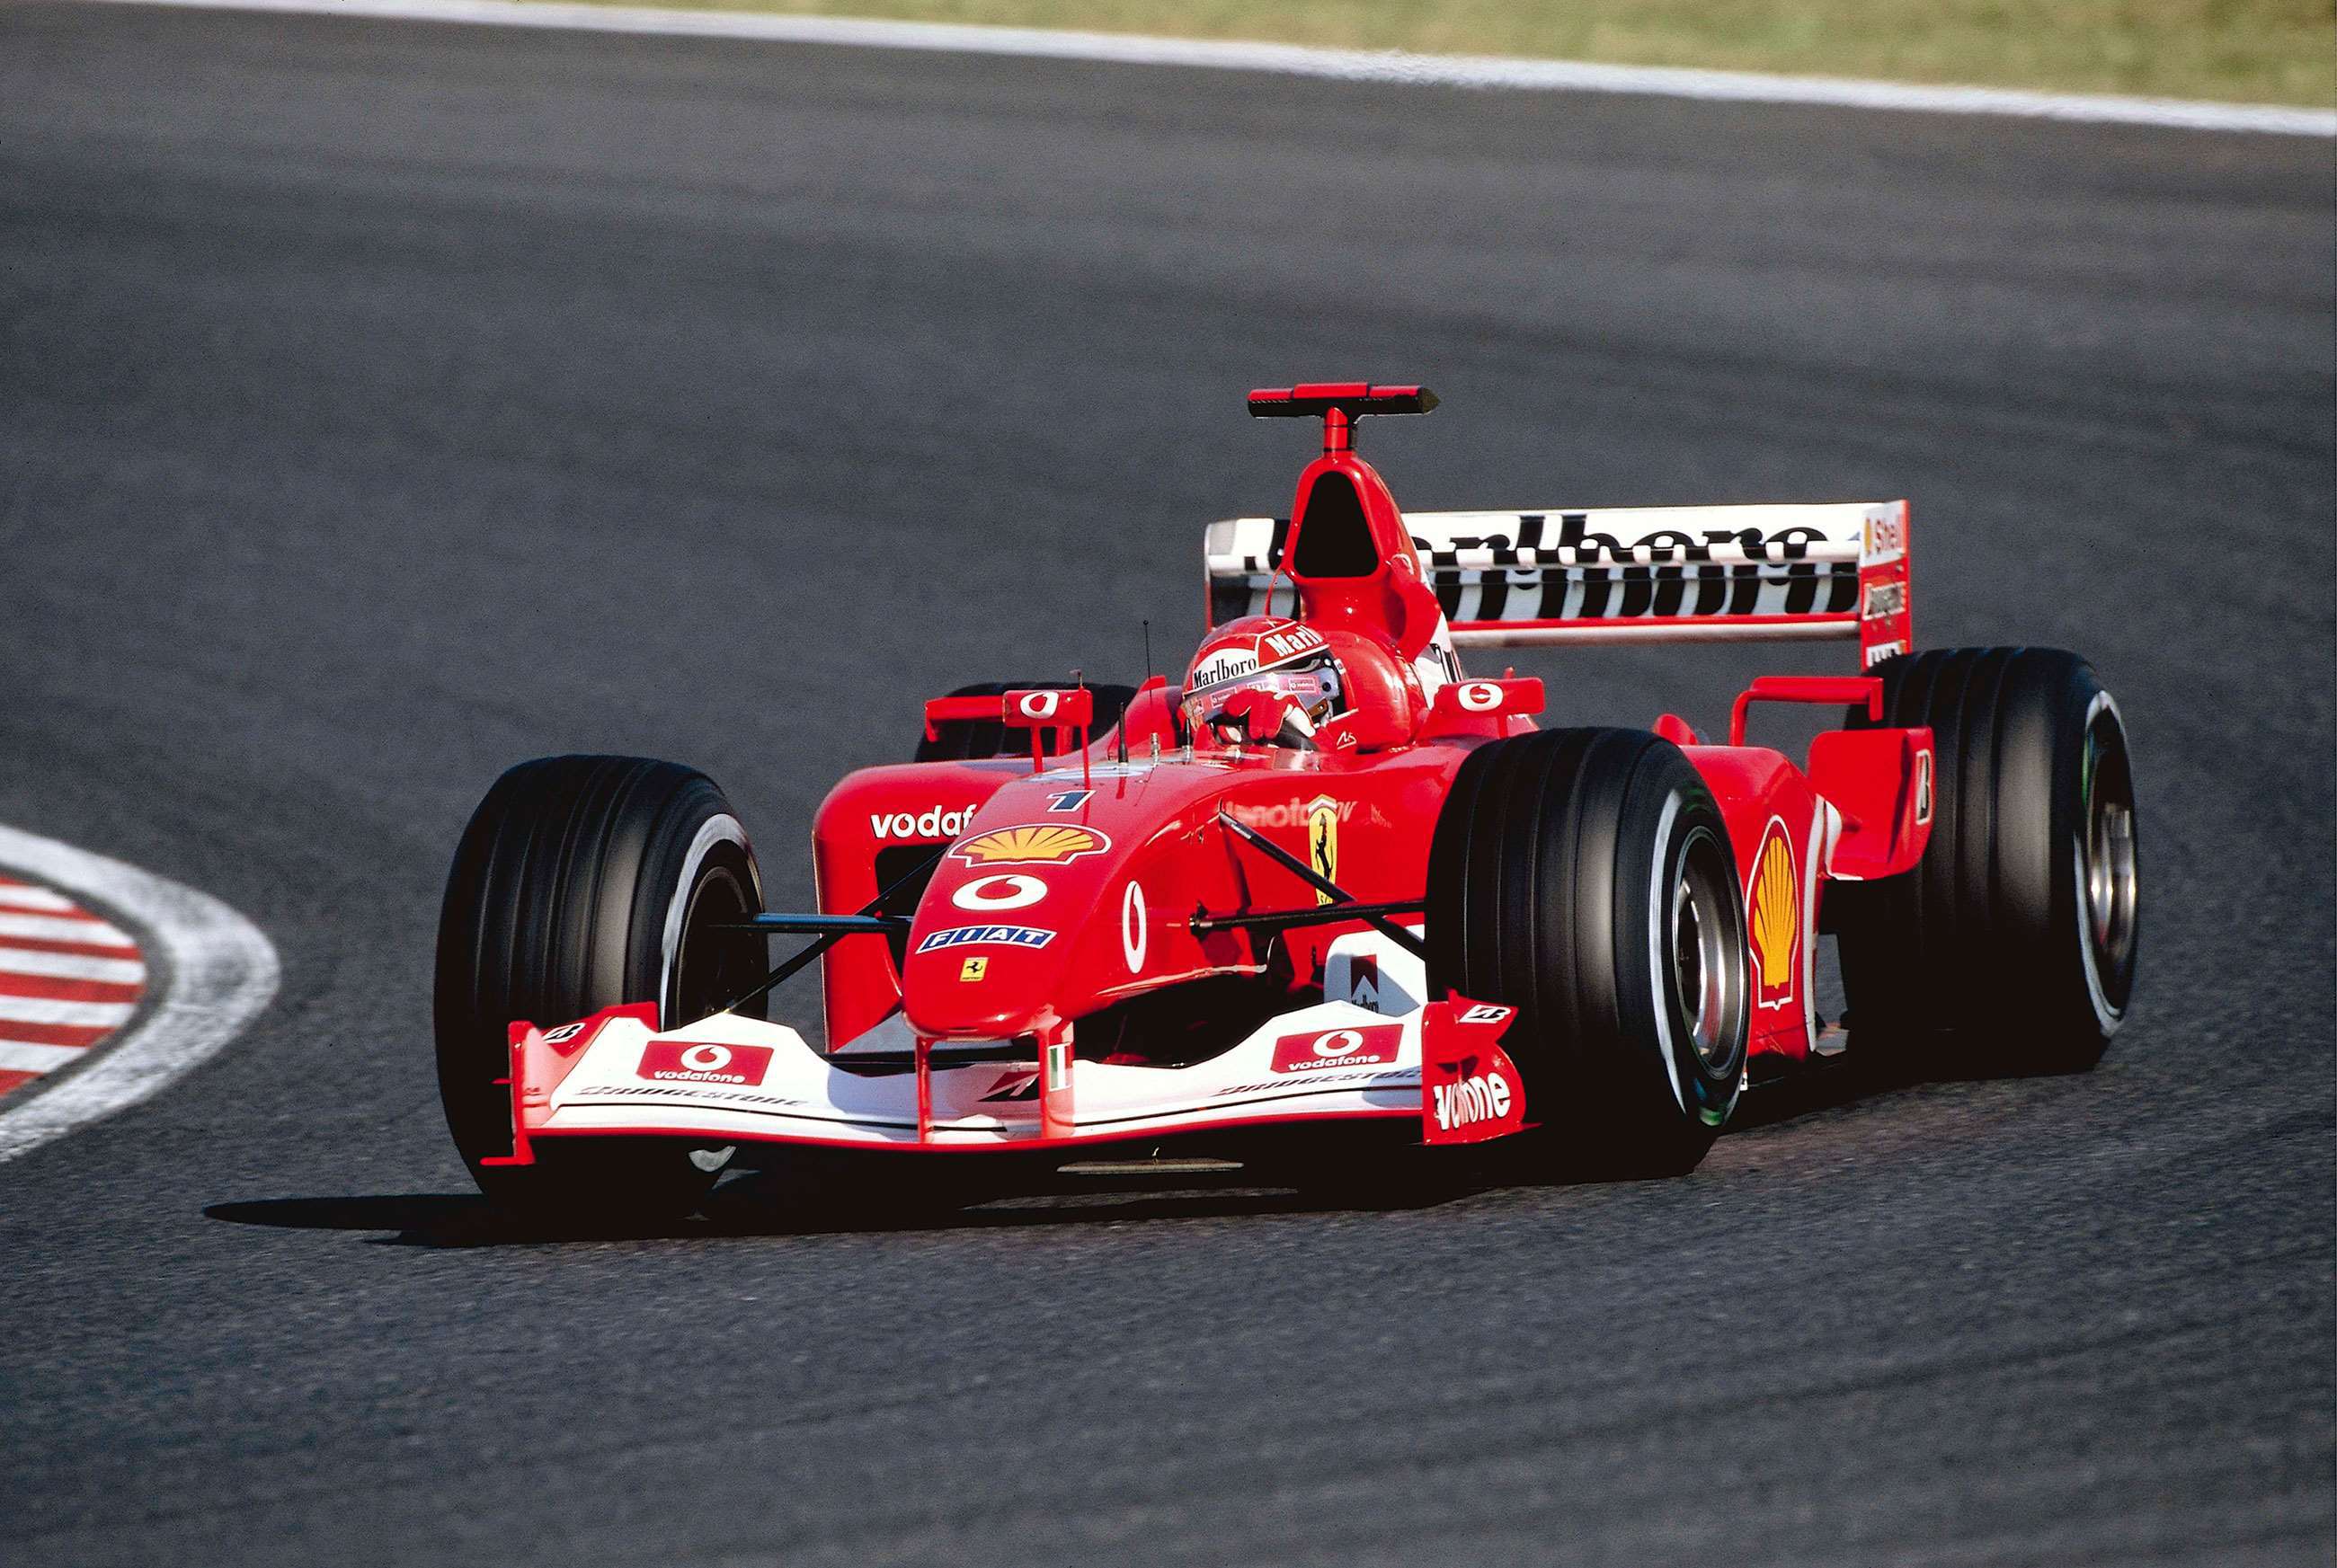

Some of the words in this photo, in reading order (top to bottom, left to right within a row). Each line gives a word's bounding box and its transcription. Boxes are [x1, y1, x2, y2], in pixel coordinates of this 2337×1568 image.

[1194, 658, 1257, 689] Marlboro
[871, 804, 977, 838] vodaf
[927, 926, 1050, 949] FIAT
[1288, 1055, 1381, 1071] vodafone
[654, 1070, 746, 1083] vodafone
